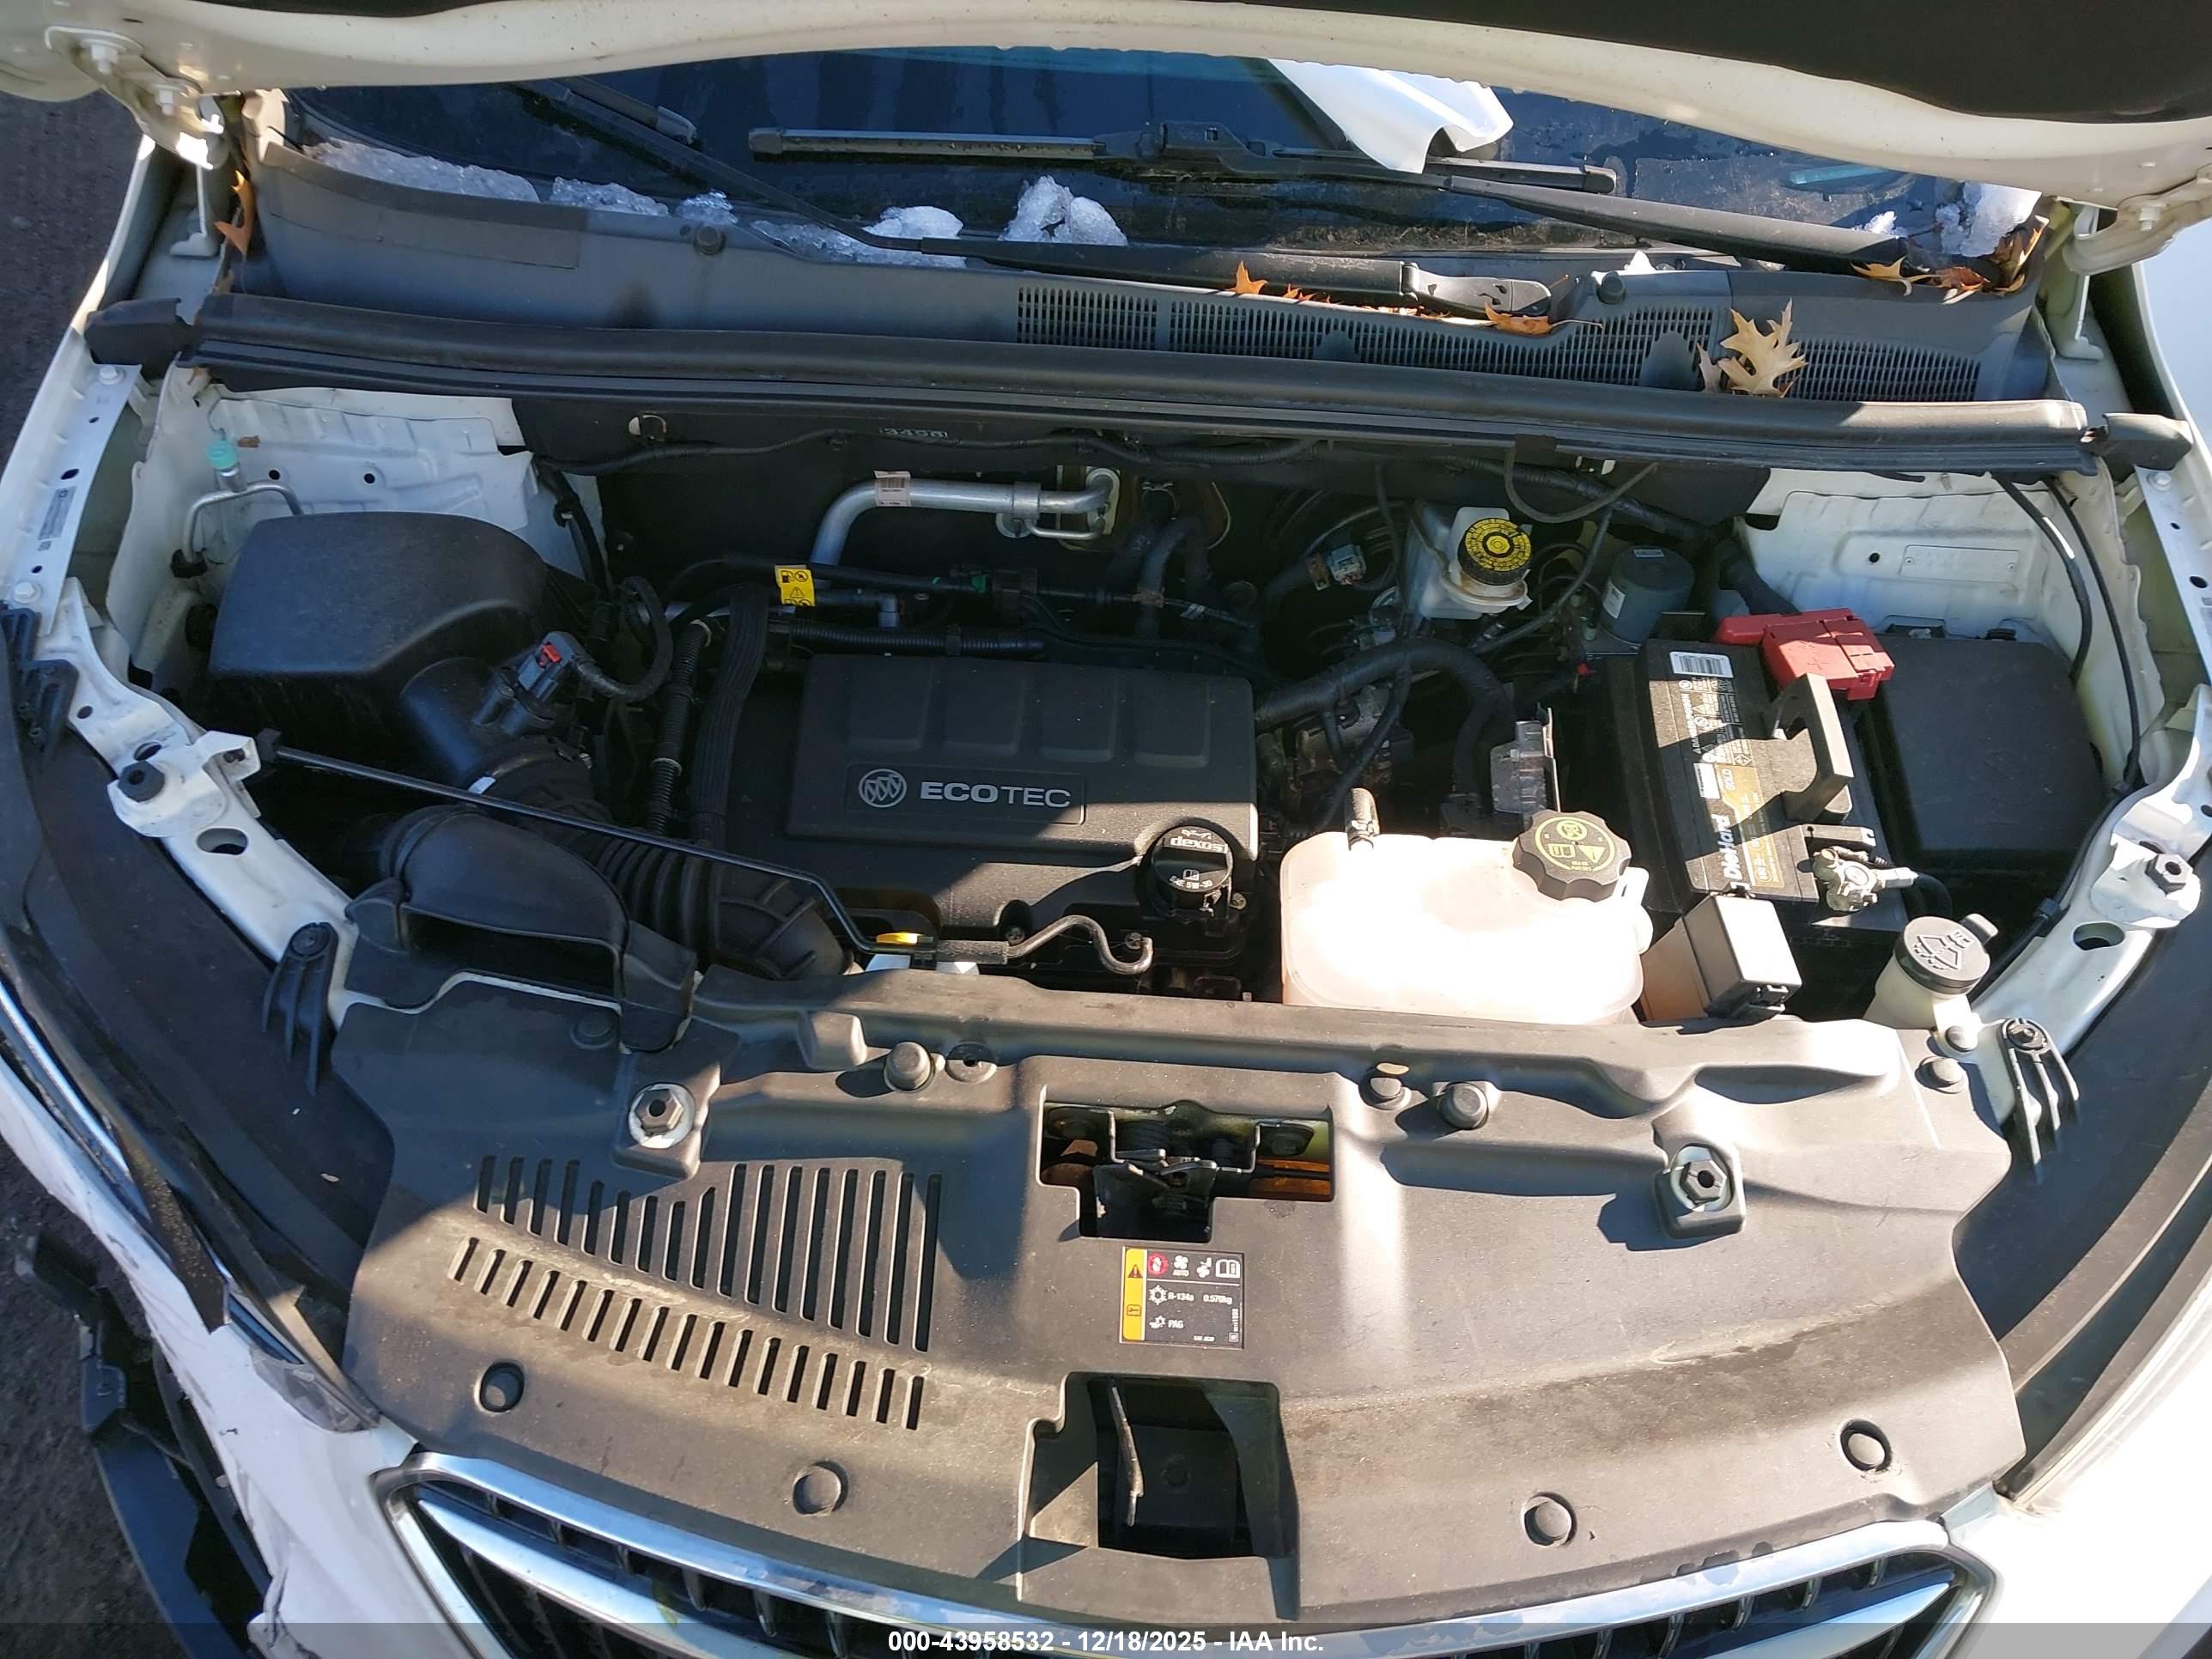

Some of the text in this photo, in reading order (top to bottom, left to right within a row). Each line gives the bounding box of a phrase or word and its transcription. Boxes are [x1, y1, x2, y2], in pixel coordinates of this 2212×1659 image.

[920, 781, 1072, 808] ECOTEC
[1711, 814, 1743, 880] DieHard
[1168, 1319, 1184, 1329] PAG
